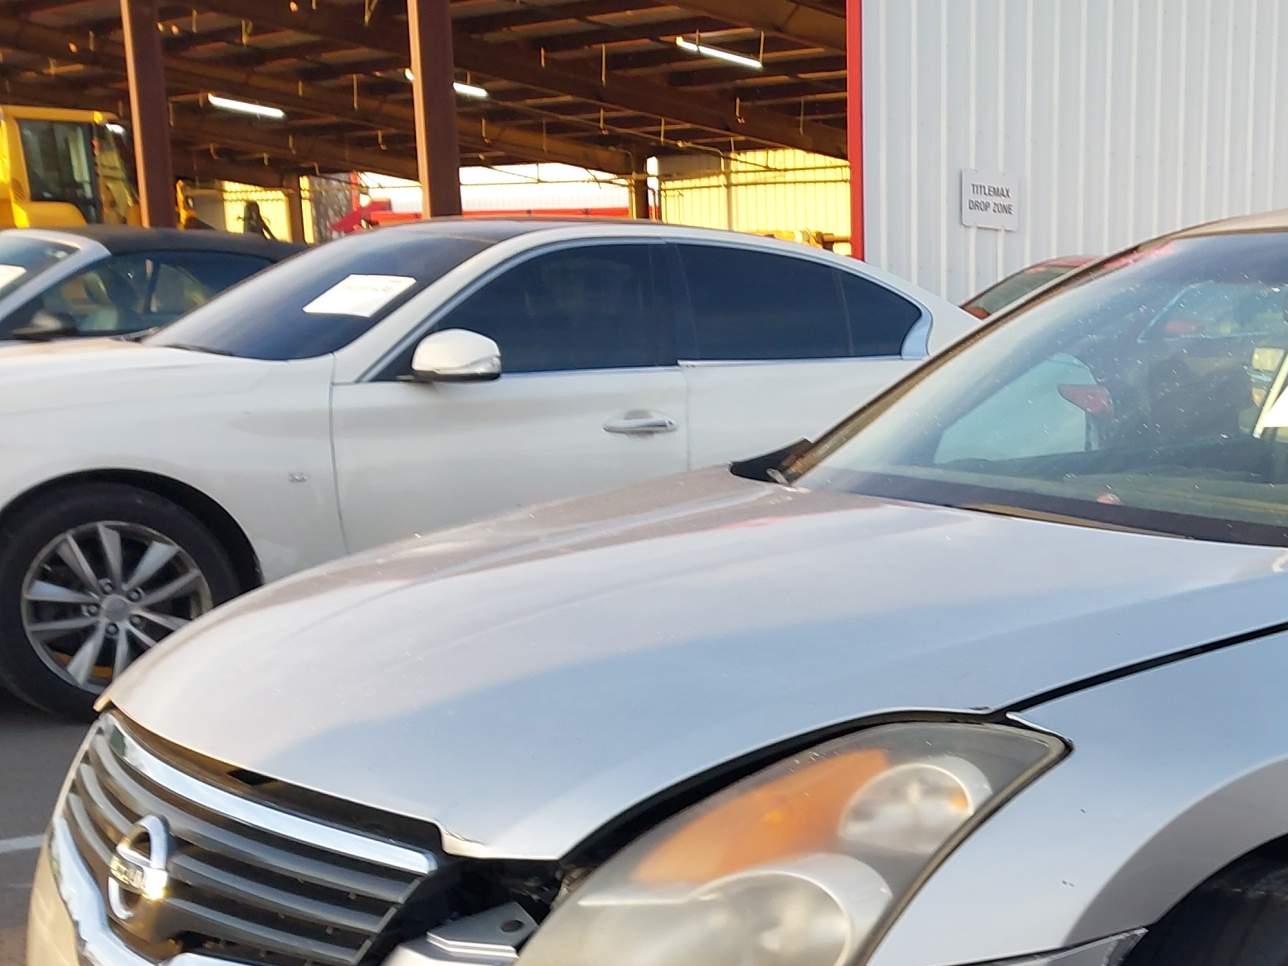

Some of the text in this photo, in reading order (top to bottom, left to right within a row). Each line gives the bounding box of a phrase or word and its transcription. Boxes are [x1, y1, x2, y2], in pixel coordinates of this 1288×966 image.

[970, 183, 1011, 198] TITLEMAX
[968, 199, 1014, 215] DROP ZONE
